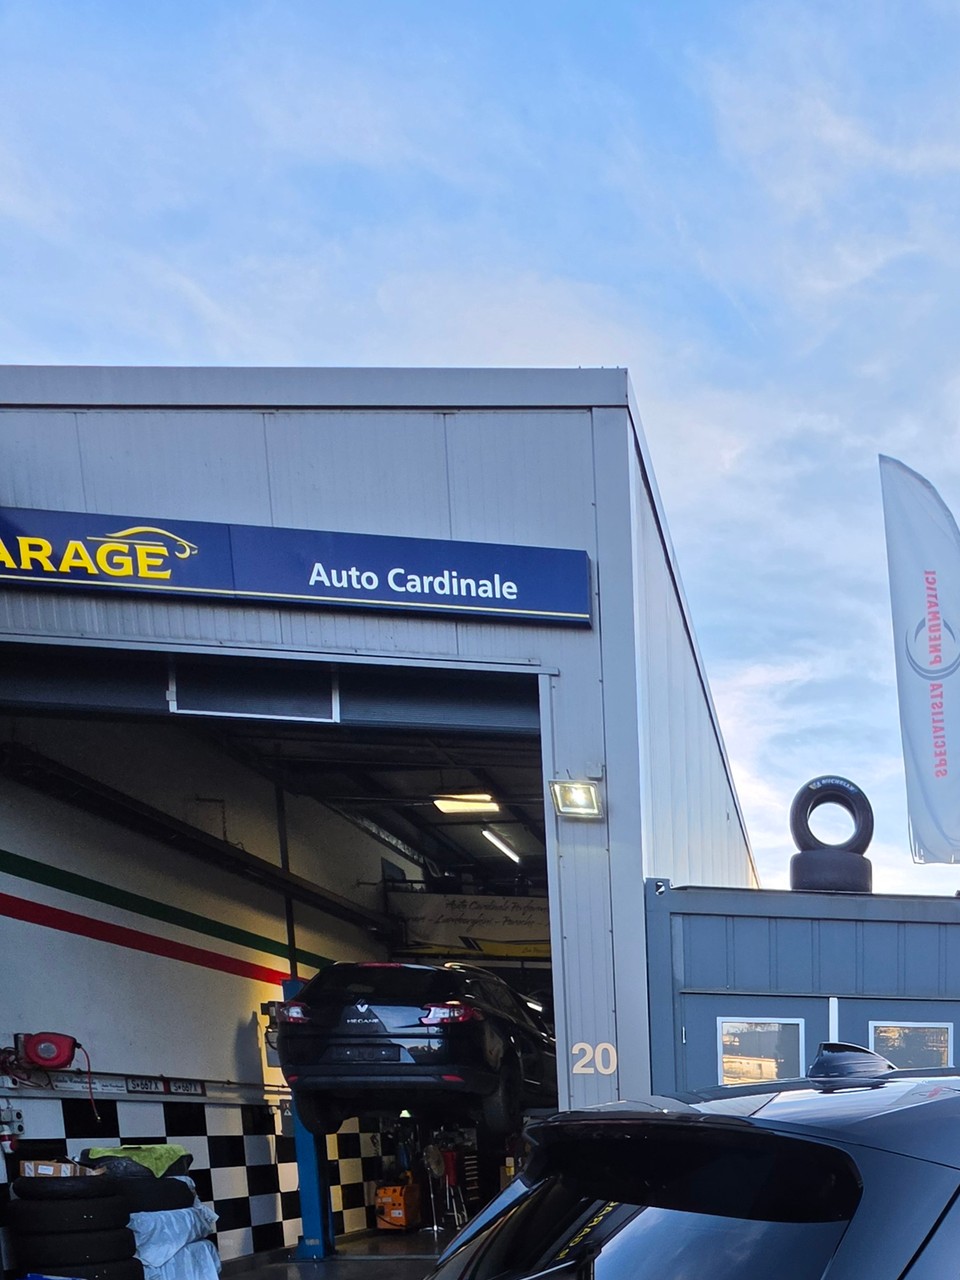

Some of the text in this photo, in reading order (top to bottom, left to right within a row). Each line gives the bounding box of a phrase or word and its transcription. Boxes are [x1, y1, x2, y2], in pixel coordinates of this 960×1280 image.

[309, 562, 518, 600] Auto Cardinale
[821, 778, 856, 791] MICHELIN
[571, 1042, 617, 1075] 20
